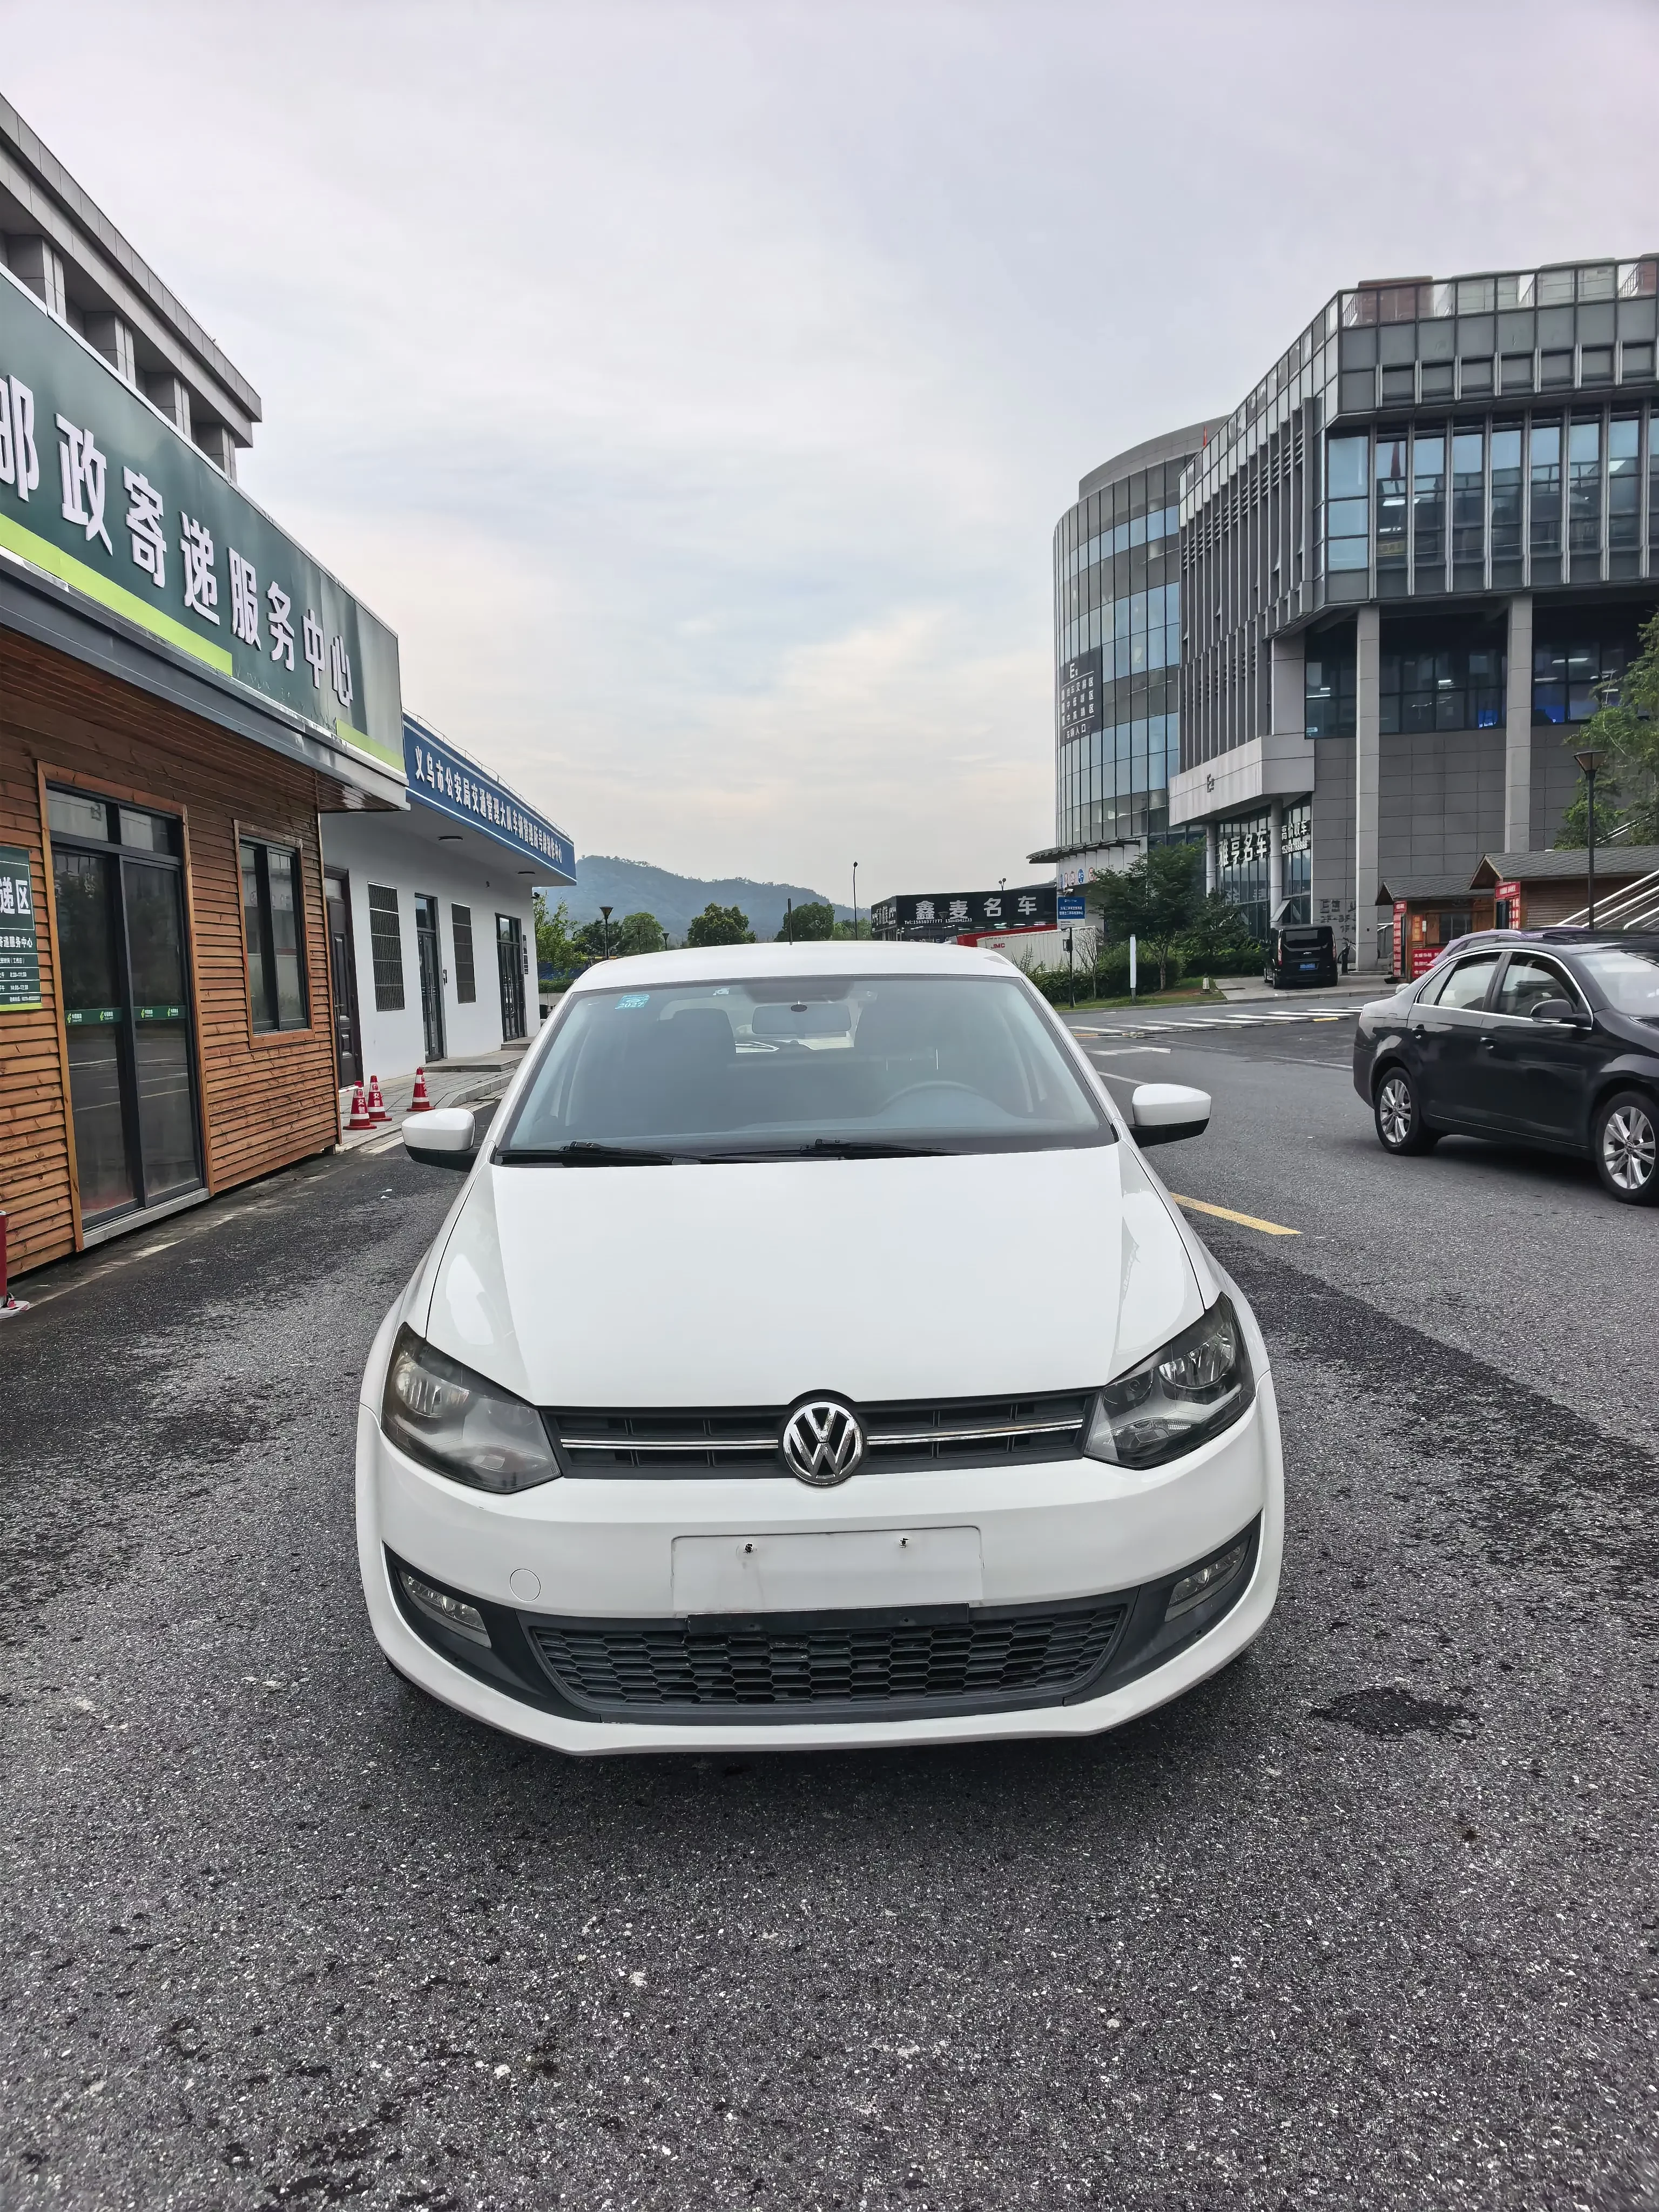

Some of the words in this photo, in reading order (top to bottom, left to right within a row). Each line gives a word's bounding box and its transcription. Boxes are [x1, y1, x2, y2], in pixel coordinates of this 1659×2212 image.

[0, 374, 353, 707] 邮政寄递服务中心
[915, 895, 1037, 920] 鑫麦名车
